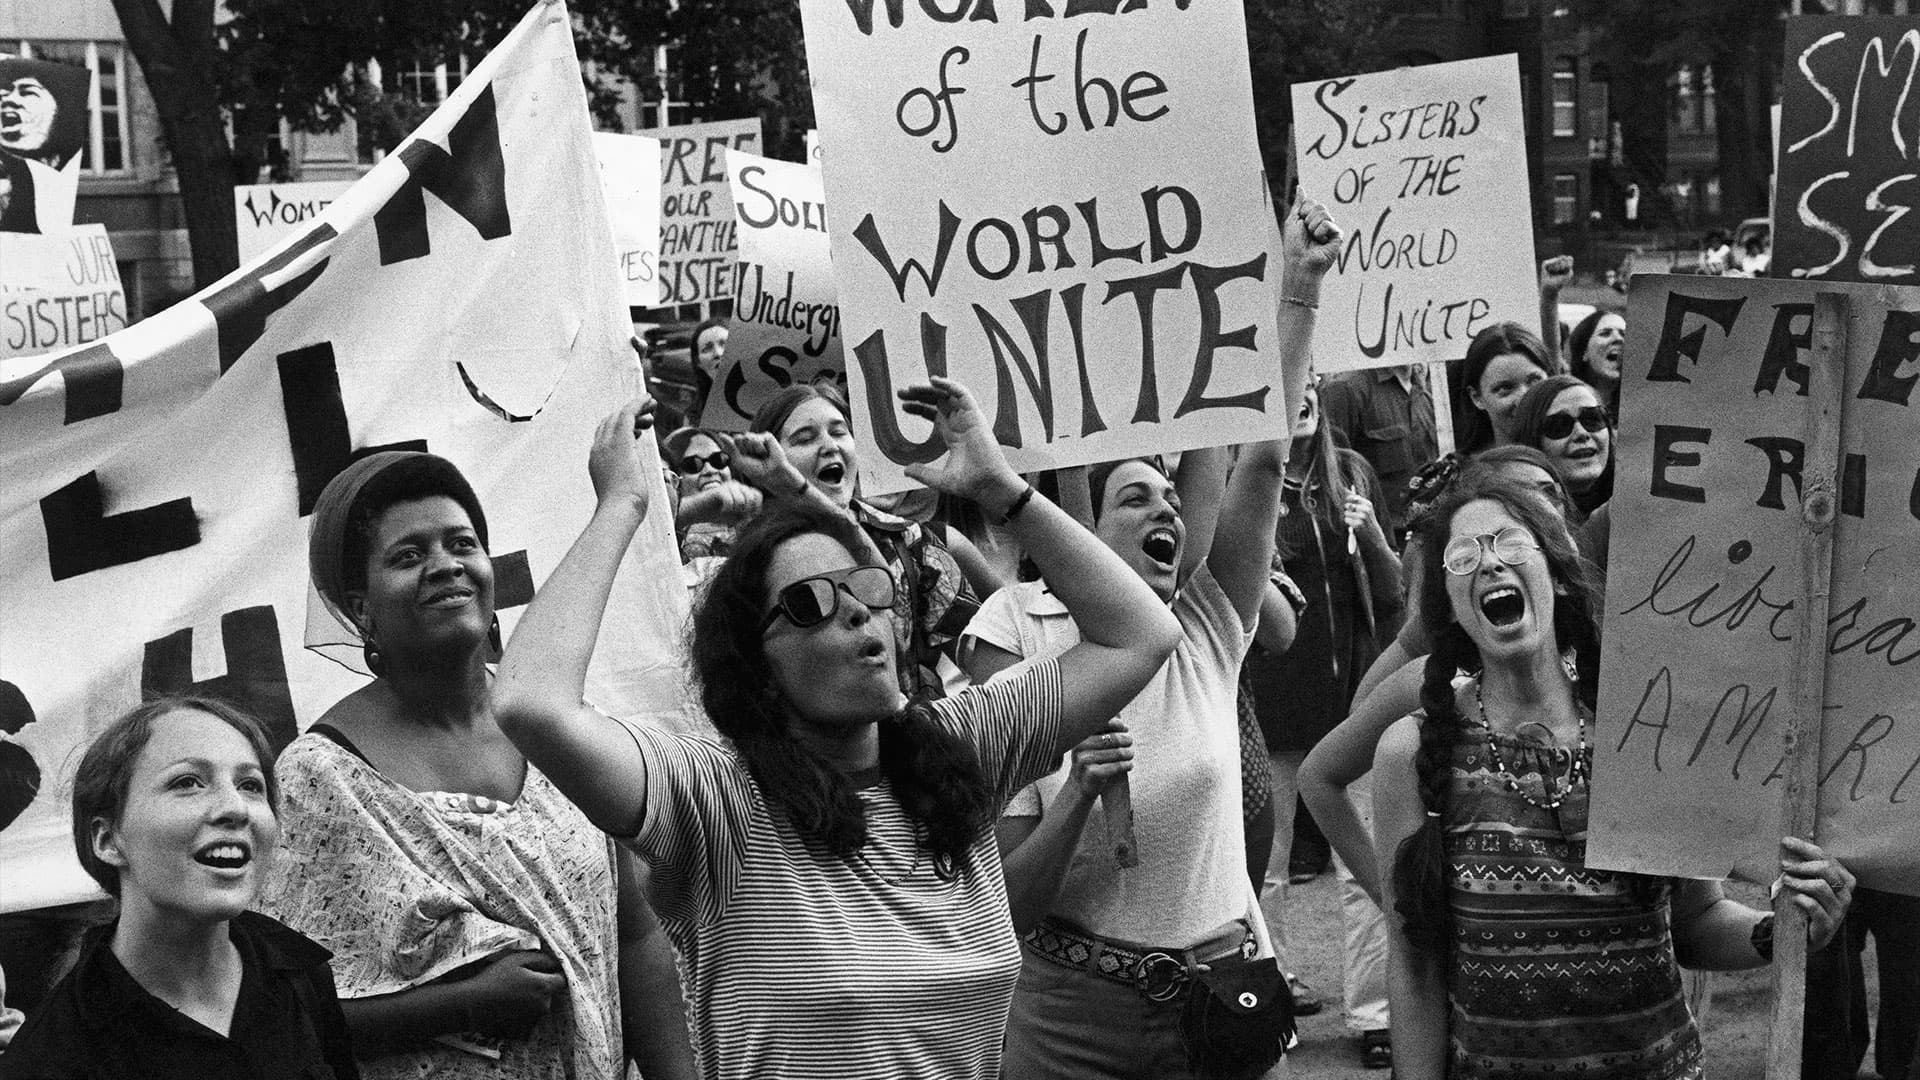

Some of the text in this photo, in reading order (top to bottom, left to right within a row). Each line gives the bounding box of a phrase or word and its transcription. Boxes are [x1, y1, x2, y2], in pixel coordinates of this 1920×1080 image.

[896, 28, 1170, 153] of the
[663, 190, 712, 217] OUR
[1334, 154, 1465, 204] OF THE
[852, 184, 1202, 301] WORLD
[1336, 205, 1458, 276] WORLD
[5, 291, 127, 350] SISTERS
[852, 253, 1271, 466] UNITE
